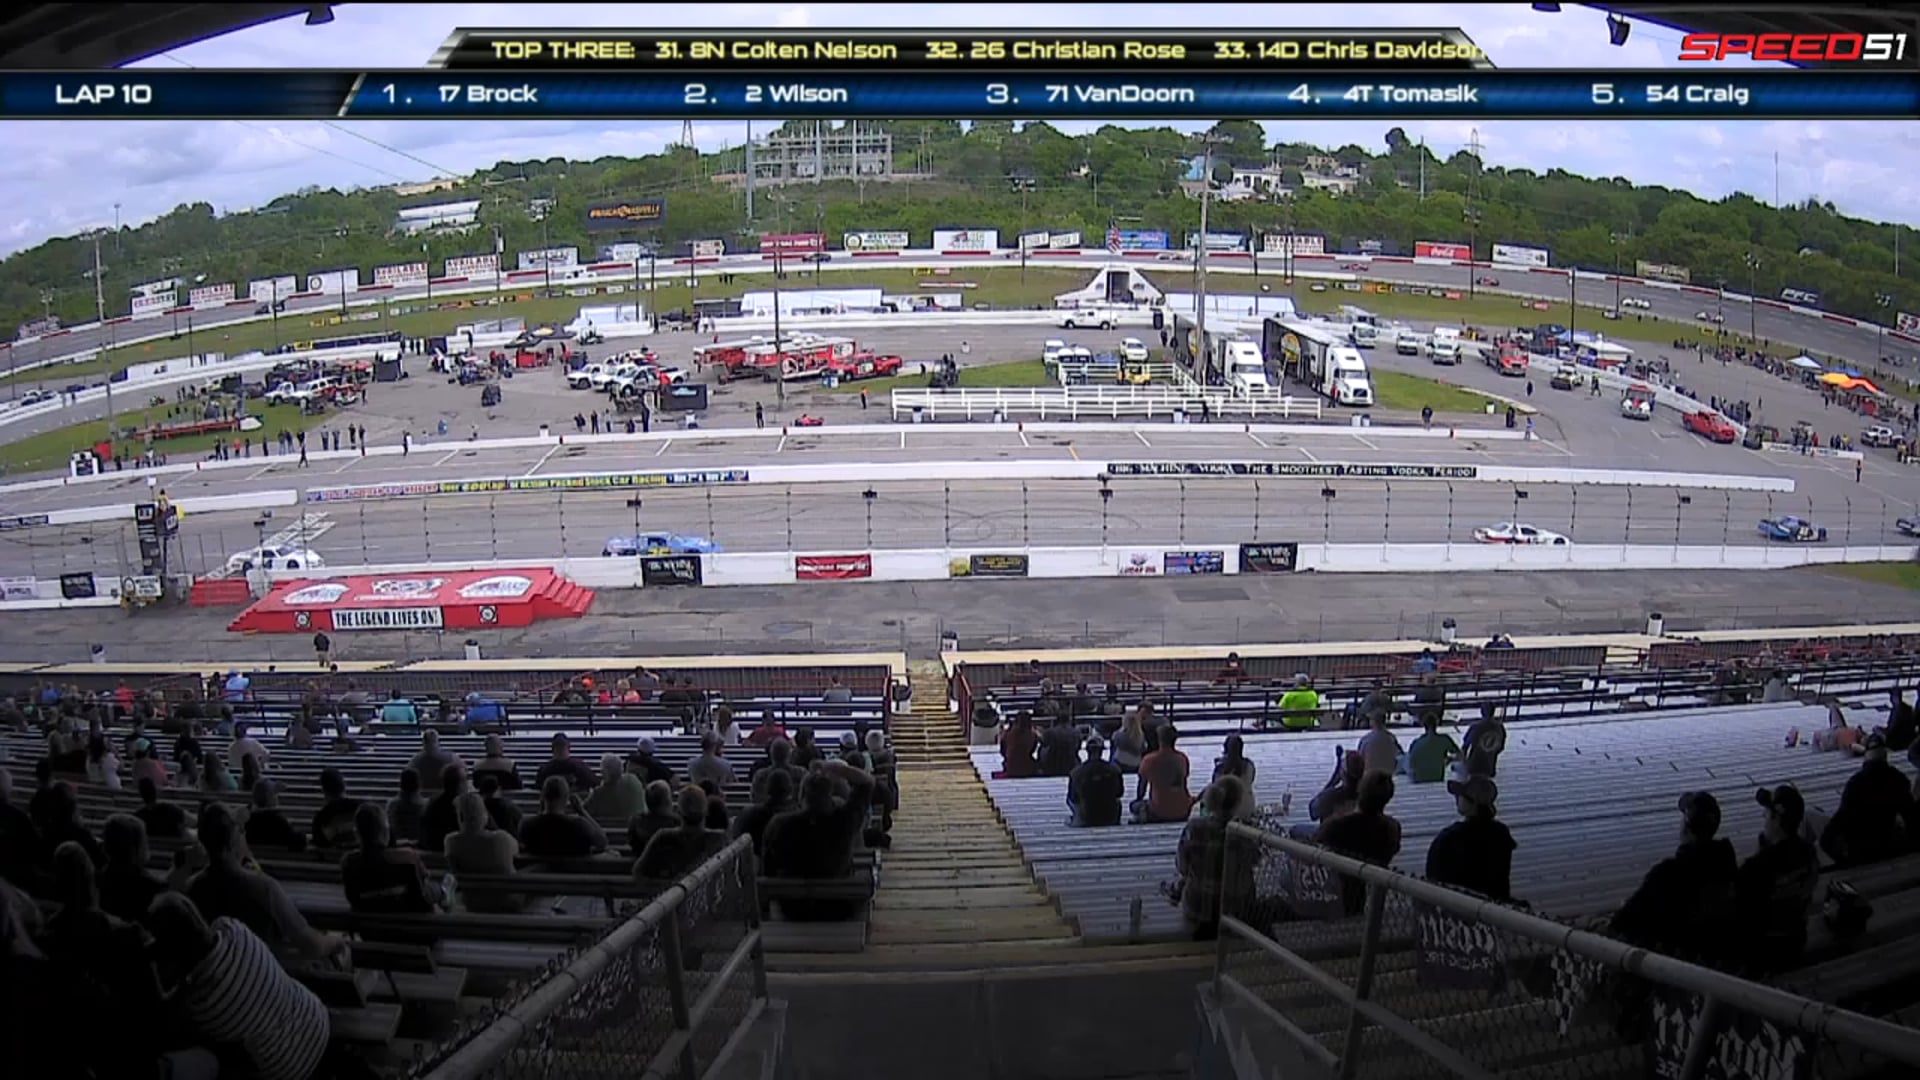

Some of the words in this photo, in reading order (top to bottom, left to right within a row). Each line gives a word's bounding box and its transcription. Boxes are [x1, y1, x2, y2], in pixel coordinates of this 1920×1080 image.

[1246, 464, 1267, 475] THE
[1272, 464, 1338, 476] SMOOTHEST
[1343, 464, 1387, 475] TASTING
[335, 609, 353, 628] THE
[354, 609, 390, 628] LEGEND
[392, 609, 418, 627] LIVES
